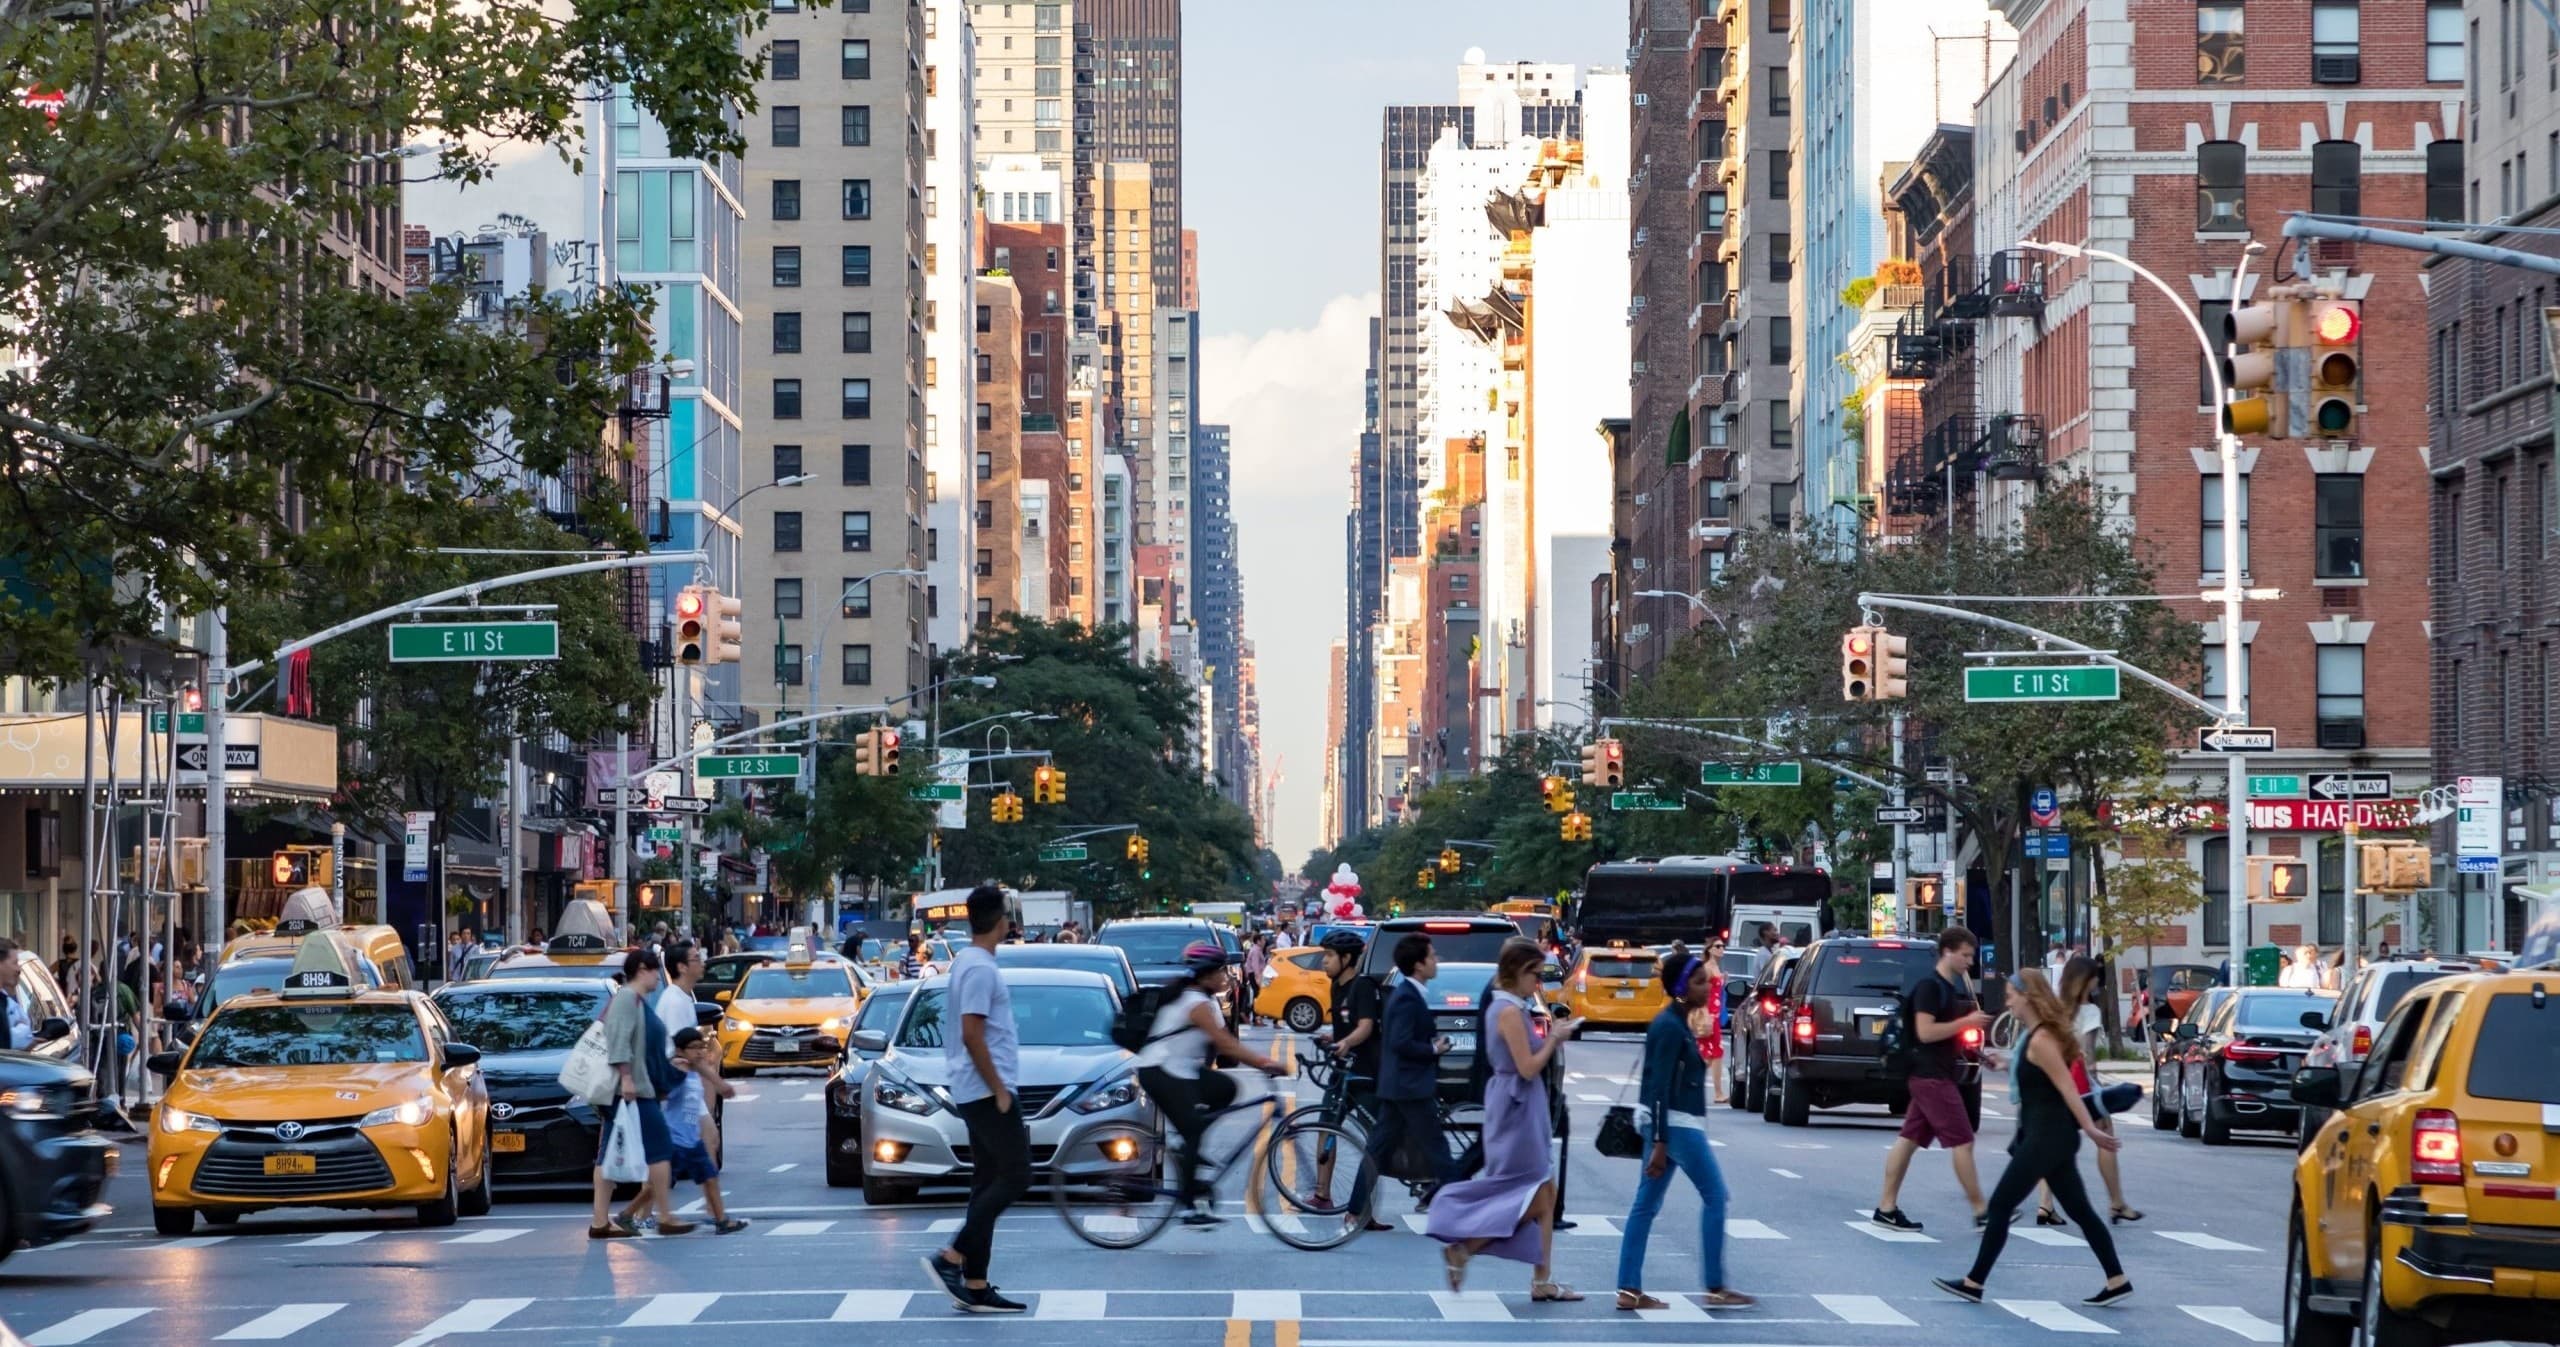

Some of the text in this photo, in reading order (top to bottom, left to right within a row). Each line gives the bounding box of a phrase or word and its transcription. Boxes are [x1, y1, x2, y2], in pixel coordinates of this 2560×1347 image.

[443, 631, 504, 652] E 11 St
[2014, 673, 2070, 693] E 11 St
[156, 715, 165, 731] E
[2214, 736, 2267, 746] ONE WAY
[191, 752, 251, 763] ON WAY
[727, 759, 770, 774] E 12 St
[1759, 767, 1771, 780] St
[2255, 778, 2263, 793] E
[2269, 778, 2277, 792] 11
[2324, 781, 2383, 792] ONE WAY
[652, 829, 658, 839] E
[567, 935, 587, 948] 7C47
[302, 972, 331, 987] 8H94
[275, 1155, 297, 1169] 8H94
